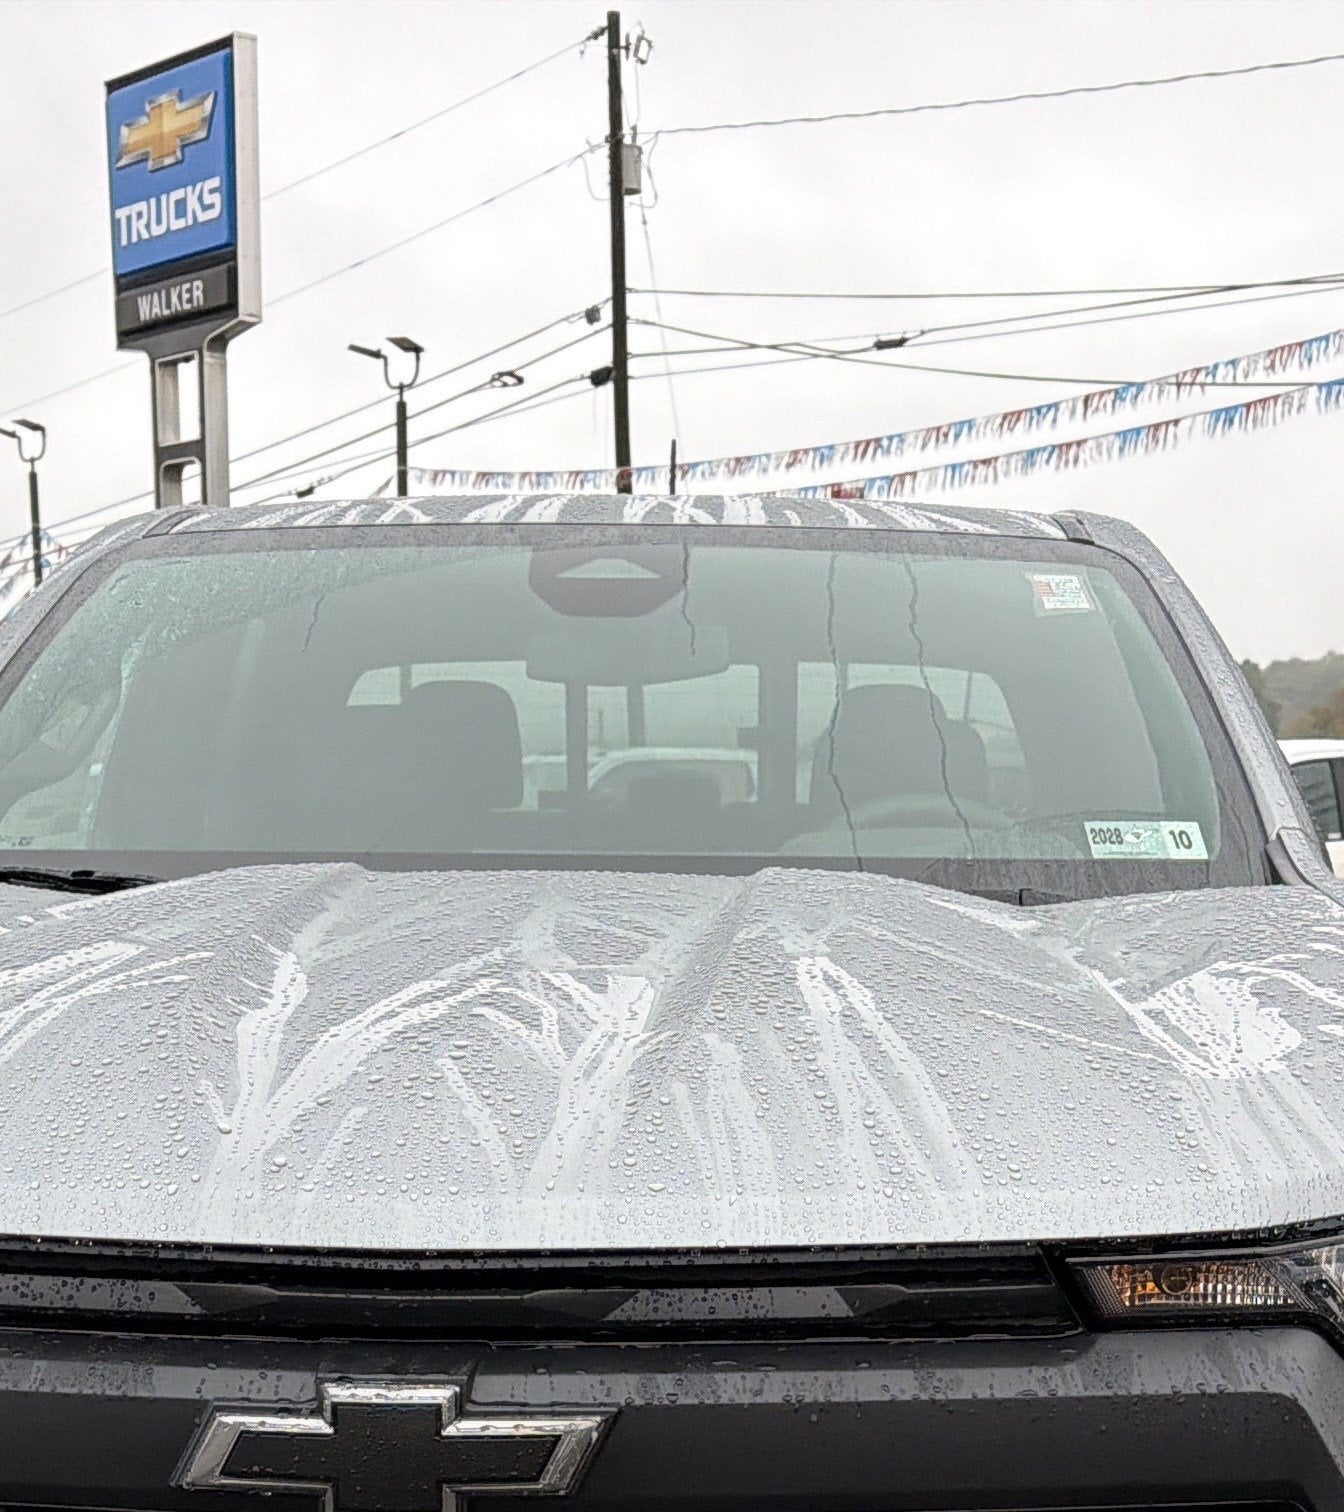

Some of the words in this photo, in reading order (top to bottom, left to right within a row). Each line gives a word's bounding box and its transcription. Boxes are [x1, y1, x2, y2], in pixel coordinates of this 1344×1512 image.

[114, 176, 222, 247] TRUCKS
[137, 279, 205, 322] WALKER
[1090, 827, 1124, 845] 2028
[1169, 829, 1193, 850] 10
